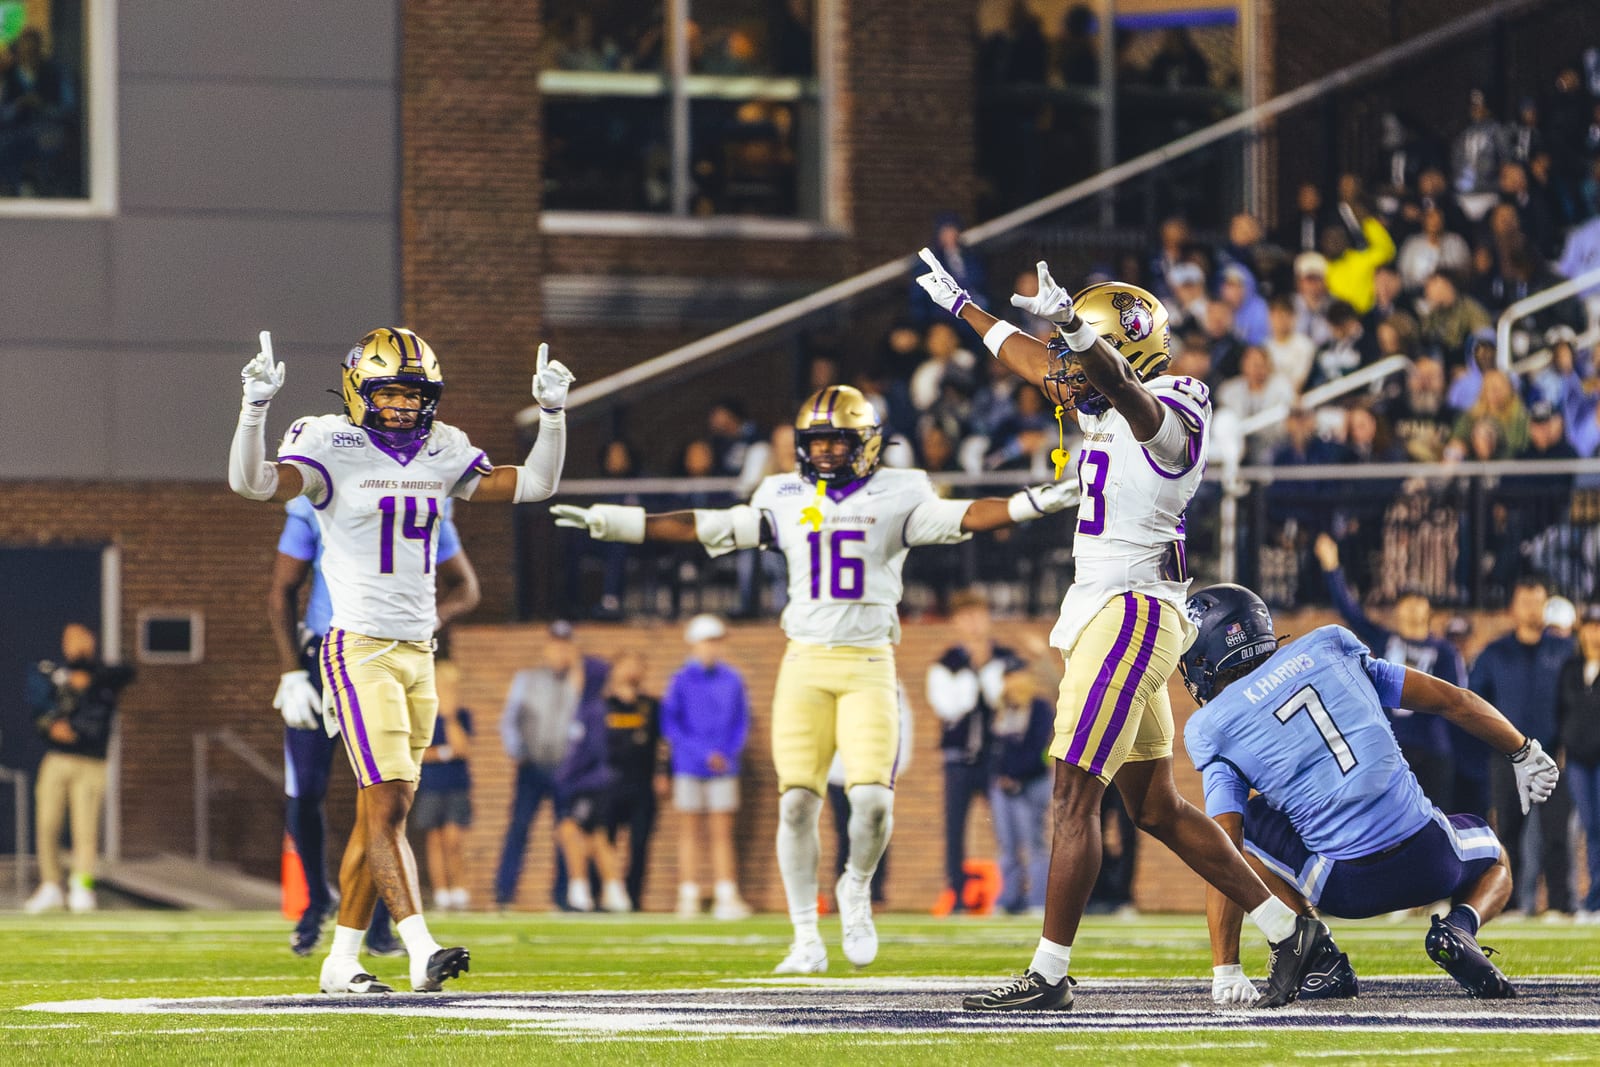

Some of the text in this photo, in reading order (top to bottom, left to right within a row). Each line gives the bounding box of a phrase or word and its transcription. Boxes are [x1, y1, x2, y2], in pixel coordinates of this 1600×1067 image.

[332, 431, 365, 448] SBC
[359, 479, 398, 489] JAMES
[377, 495, 441, 575] 14
[806, 529, 867, 600] 16
[1225, 630, 1248, 648] SBC
[1241, 646, 1254, 660] OLD
[1242, 653, 1316, 705] K.HARRIS
[1272, 683, 1359, 778] 7
